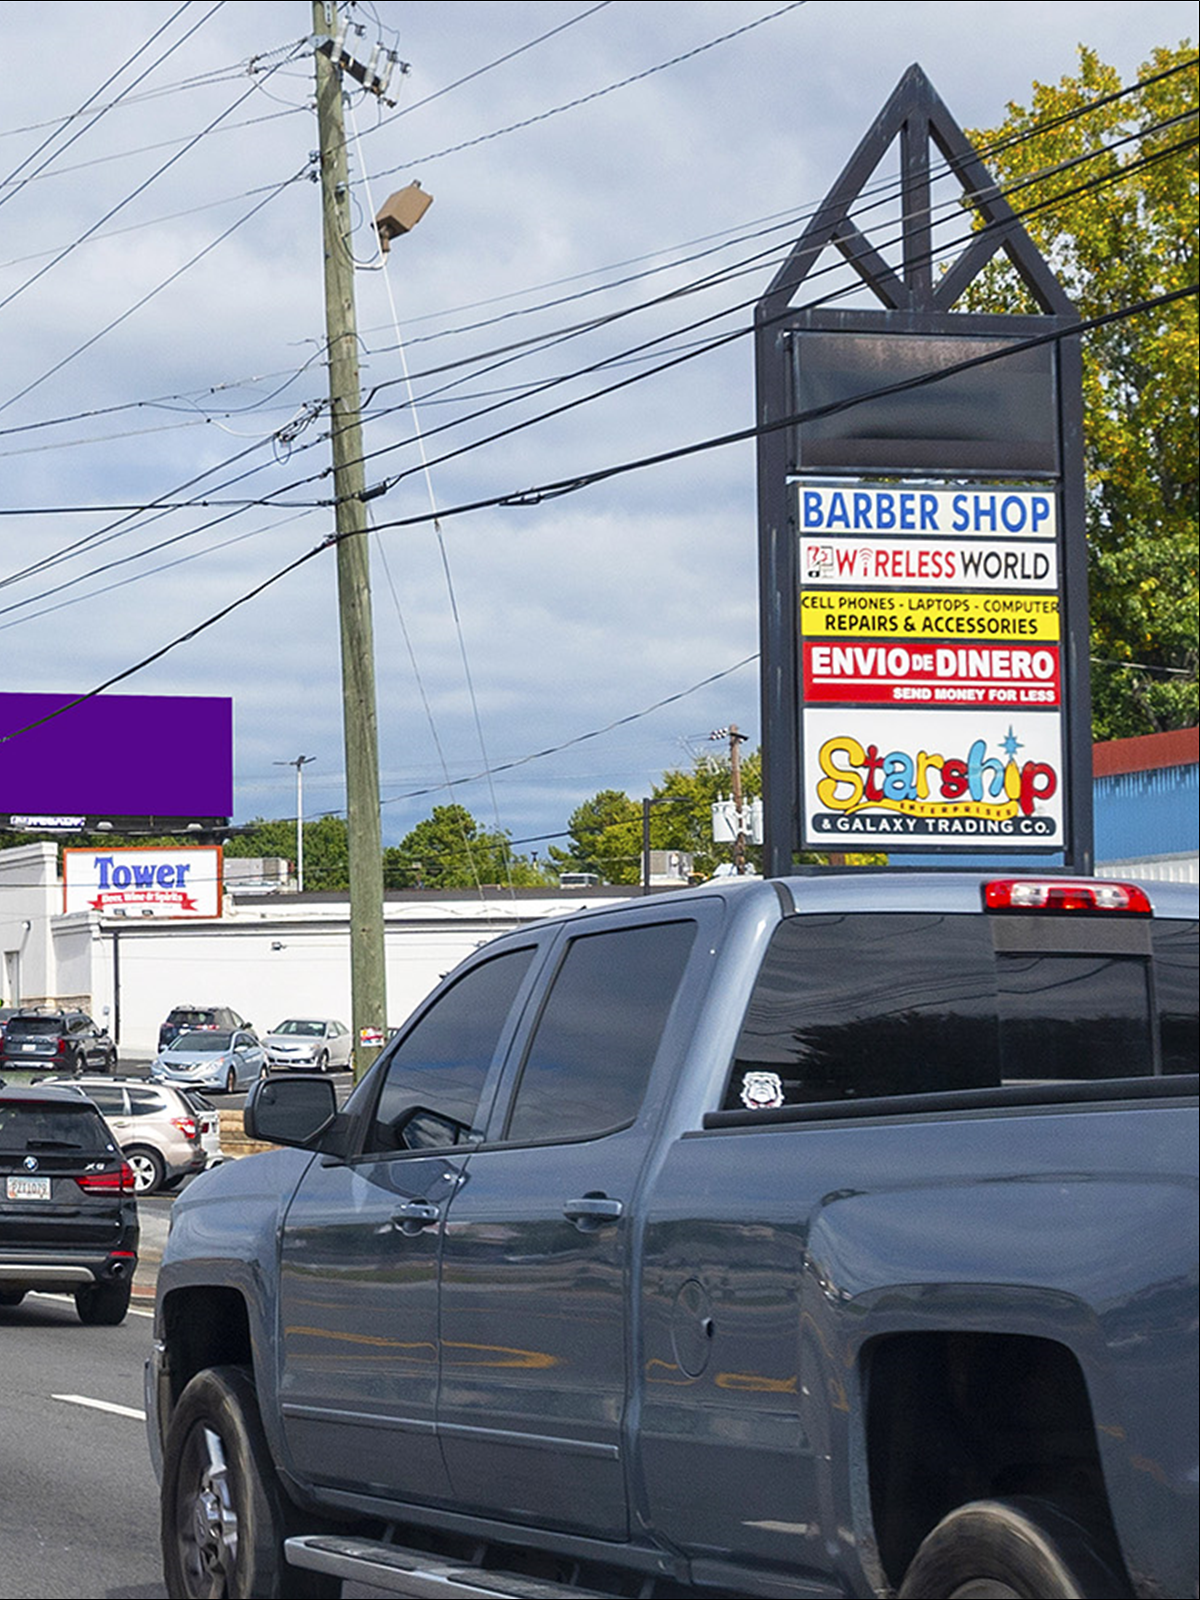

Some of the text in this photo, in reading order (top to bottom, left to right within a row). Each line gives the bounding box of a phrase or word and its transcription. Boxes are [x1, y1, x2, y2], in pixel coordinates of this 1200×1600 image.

[803, 491, 1050, 532] BARBER SHOP
[960, 550, 1050, 580] WORLD
[801, 596, 835, 610] CELL
[839, 597, 895, 611] PHONES
[908, 598, 970, 612] LAPTOPS
[825, 614, 1039, 635] REPAIRS & ACCESSORIES
[811, 646, 1055, 679] ENVIO DE DINERO
[892, 687, 1055, 702] SEND MONEY FOR LESS
[816, 734, 1057, 816] Starship
[822, 818, 832, 830] &
[836, 818, 917, 832] GALAXY
[925, 819, 1014, 834] TRADING
[94, 856, 190, 889] Tower
